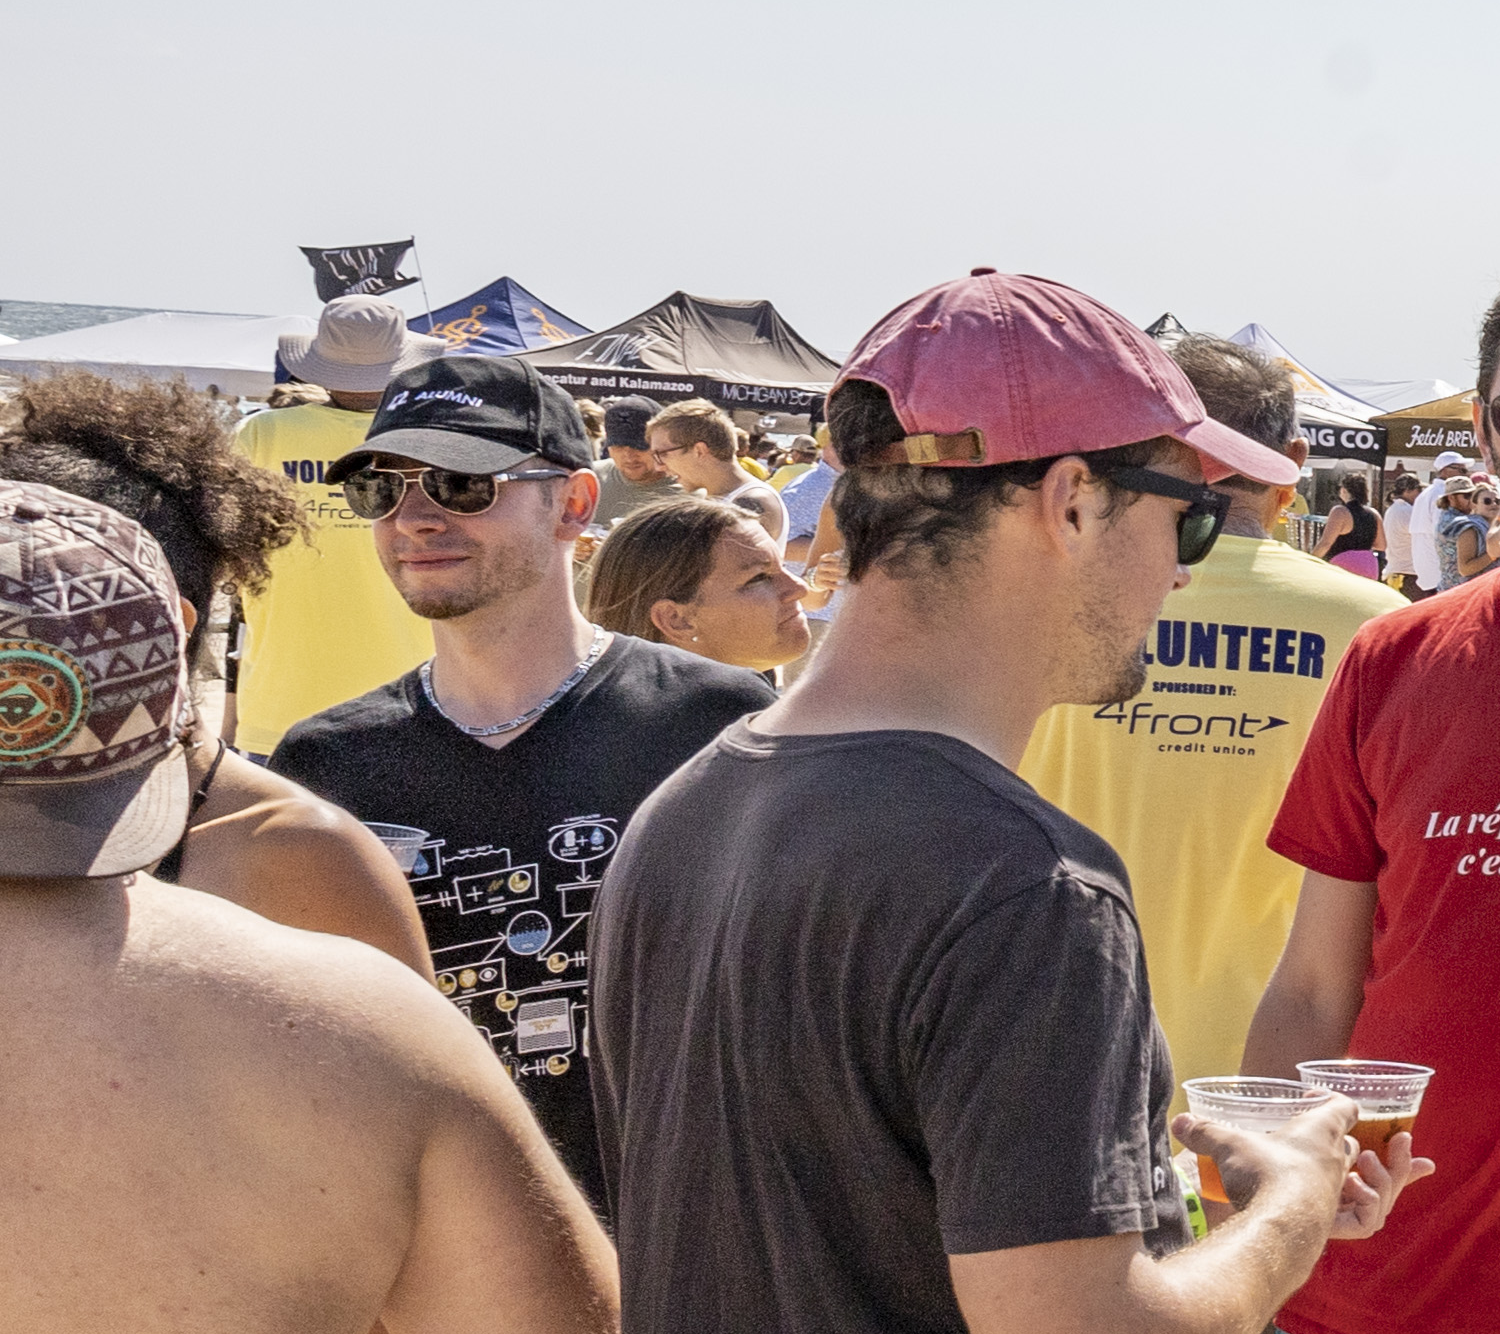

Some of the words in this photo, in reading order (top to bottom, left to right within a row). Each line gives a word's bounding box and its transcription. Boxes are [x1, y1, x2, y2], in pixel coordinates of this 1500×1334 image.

[590, 374, 616, 388] and
[619, 376, 695, 393] Kalamazoo
[722, 383, 788, 404] MICHIGAN
[414, 390, 483, 408] ALUMNI
[1340, 430, 1380, 451] CO.
[1405, 424, 1444, 449] Fetch
[1152, 681, 1216, 695] SPONSORED
[1219, 684, 1237, 696] BY:
[1093, 702, 1262, 738] 4front
[1158, 742, 1206, 754] credit
[1213, 744, 1256, 756] union
[1424, 811, 1461, 839] La
